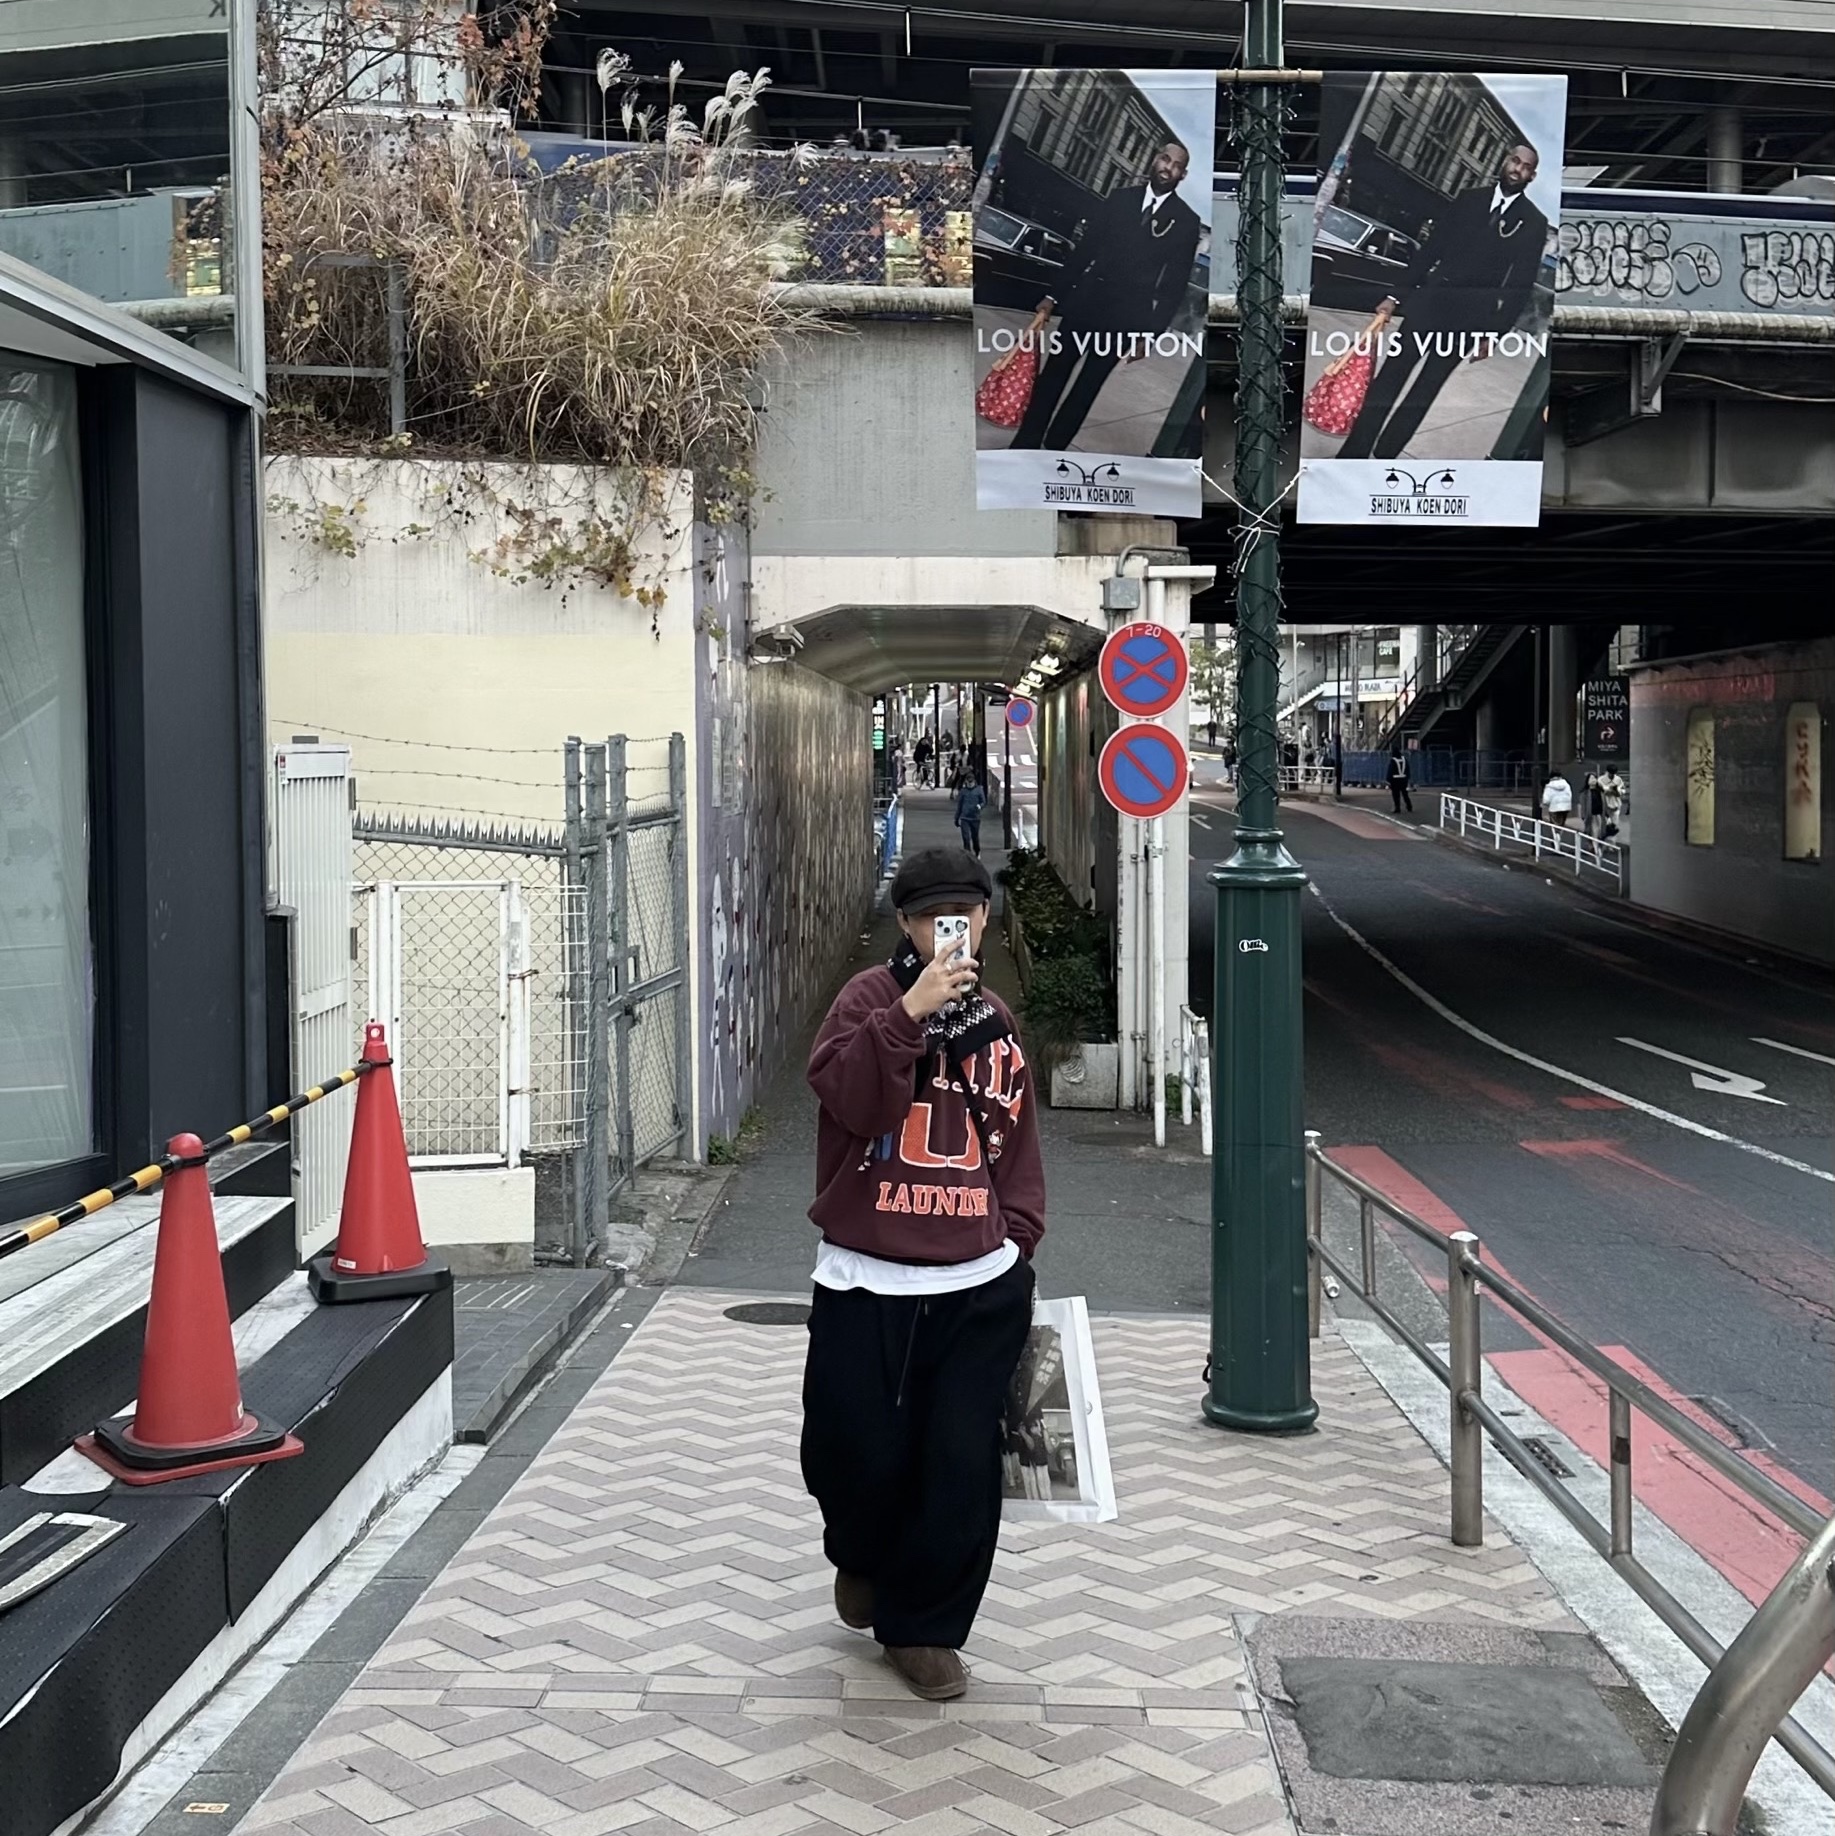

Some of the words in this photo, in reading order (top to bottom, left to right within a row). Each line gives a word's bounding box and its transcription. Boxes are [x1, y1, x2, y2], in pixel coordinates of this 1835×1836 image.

[976, 328, 1063, 355] LOUIS
[1072, 330, 1204, 358] VUITTON
[1310, 330, 1403, 358] LOUIS
[1412, 331, 1548, 359] VUITTON
[1045, 485, 1082, 501] SHIBUYA
[1087, 487, 1110, 503] KOEN
[1112, 489, 1134, 504] DORI
[1371, 497, 1411, 514] SHIBUYA
[1416, 498, 1441, 514] KOEN
[1443, 498, 1467, 515] DORI
[1587, 680, 1621, 692] MIYA
[1587, 695, 1628, 706] SHITA
[1587, 709, 1623, 720] PARK
